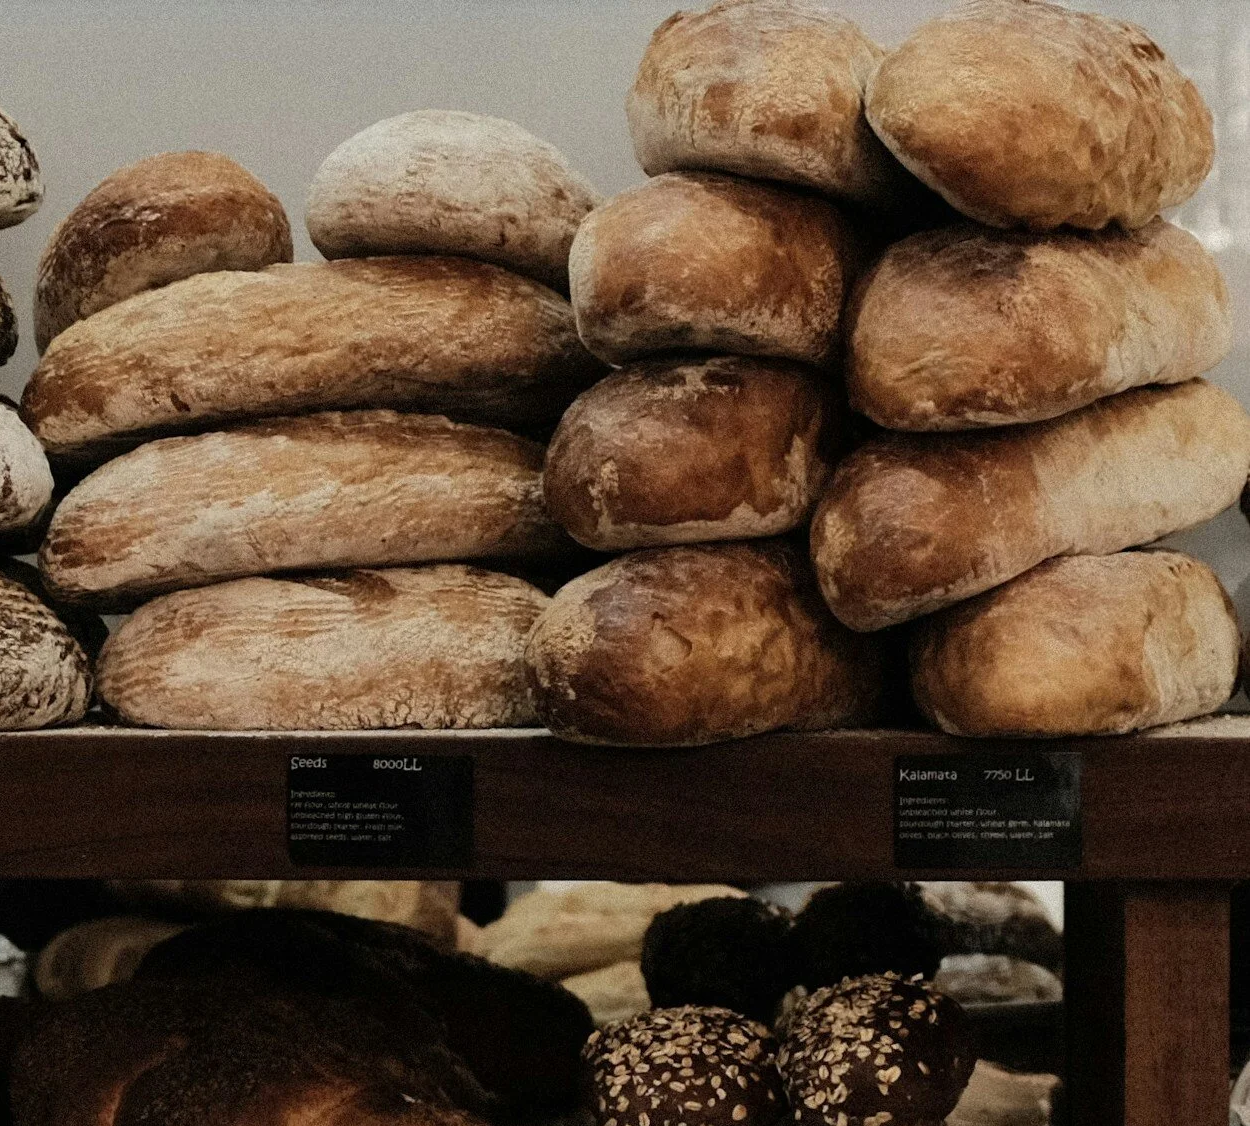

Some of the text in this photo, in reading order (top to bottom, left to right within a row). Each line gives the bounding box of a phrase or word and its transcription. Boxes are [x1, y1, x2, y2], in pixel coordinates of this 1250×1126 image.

[290, 756, 423, 772] Seeds 8000LL
[899, 767, 1035, 782] Kalamata 7750 LL
